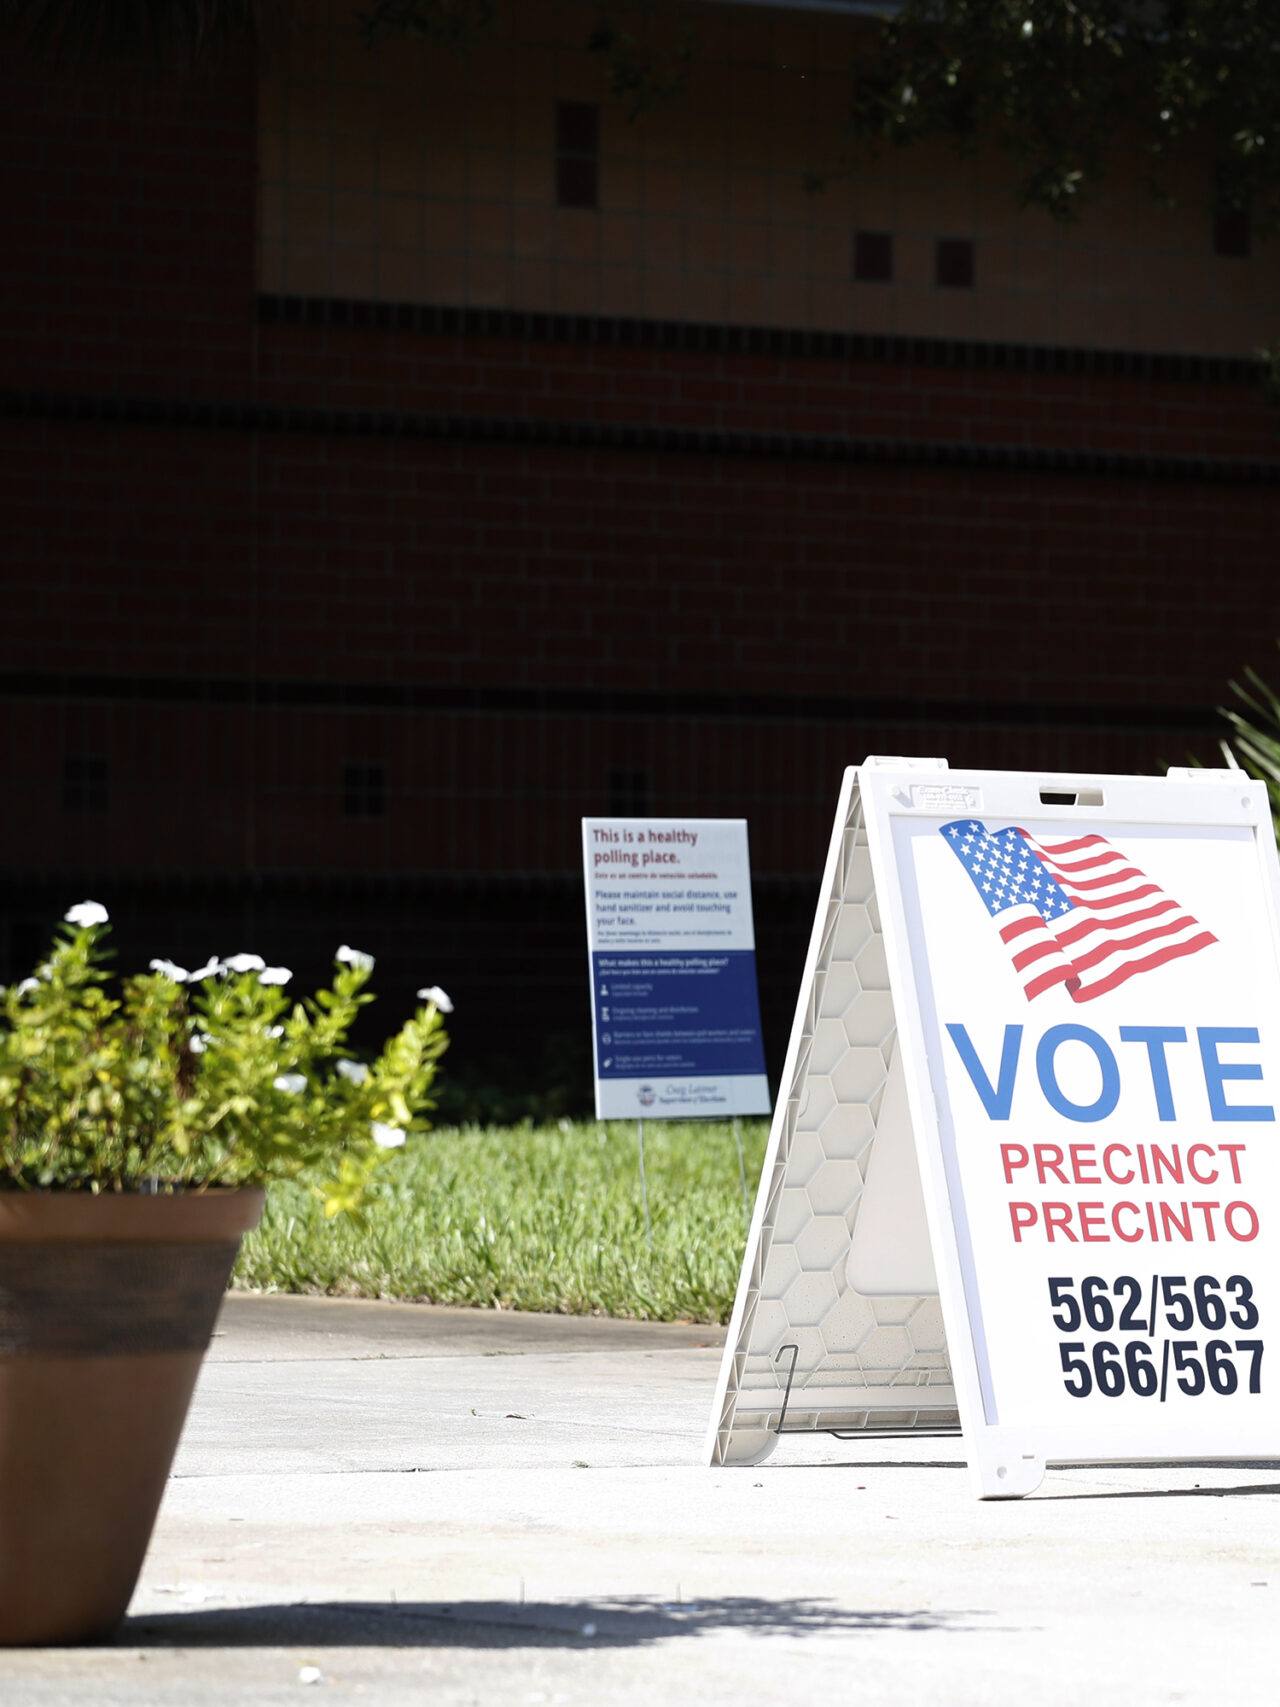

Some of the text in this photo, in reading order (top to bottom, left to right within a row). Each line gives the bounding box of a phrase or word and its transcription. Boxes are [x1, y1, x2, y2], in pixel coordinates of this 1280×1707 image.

[593, 828, 698, 847] This is a healthy
[594, 850, 680, 868] polling place.
[595, 890, 621, 899] Please
[624, 890, 659, 899] maintain
[662, 890, 684, 899] social
[686, 890, 722, 900] distance,
[596, 904, 731, 914] hand sanitizer and avoid touching
[597, 916, 636, 928] your face.
[945, 1024, 1275, 1122] VOTE
[1000, 1144, 1246, 1184] PRECINCT
[1009, 1201, 1259, 1242] PRECINTO
[1048, 1275, 1259, 1337] 562/563
[1059, 1339, 1264, 1402] 566/567
